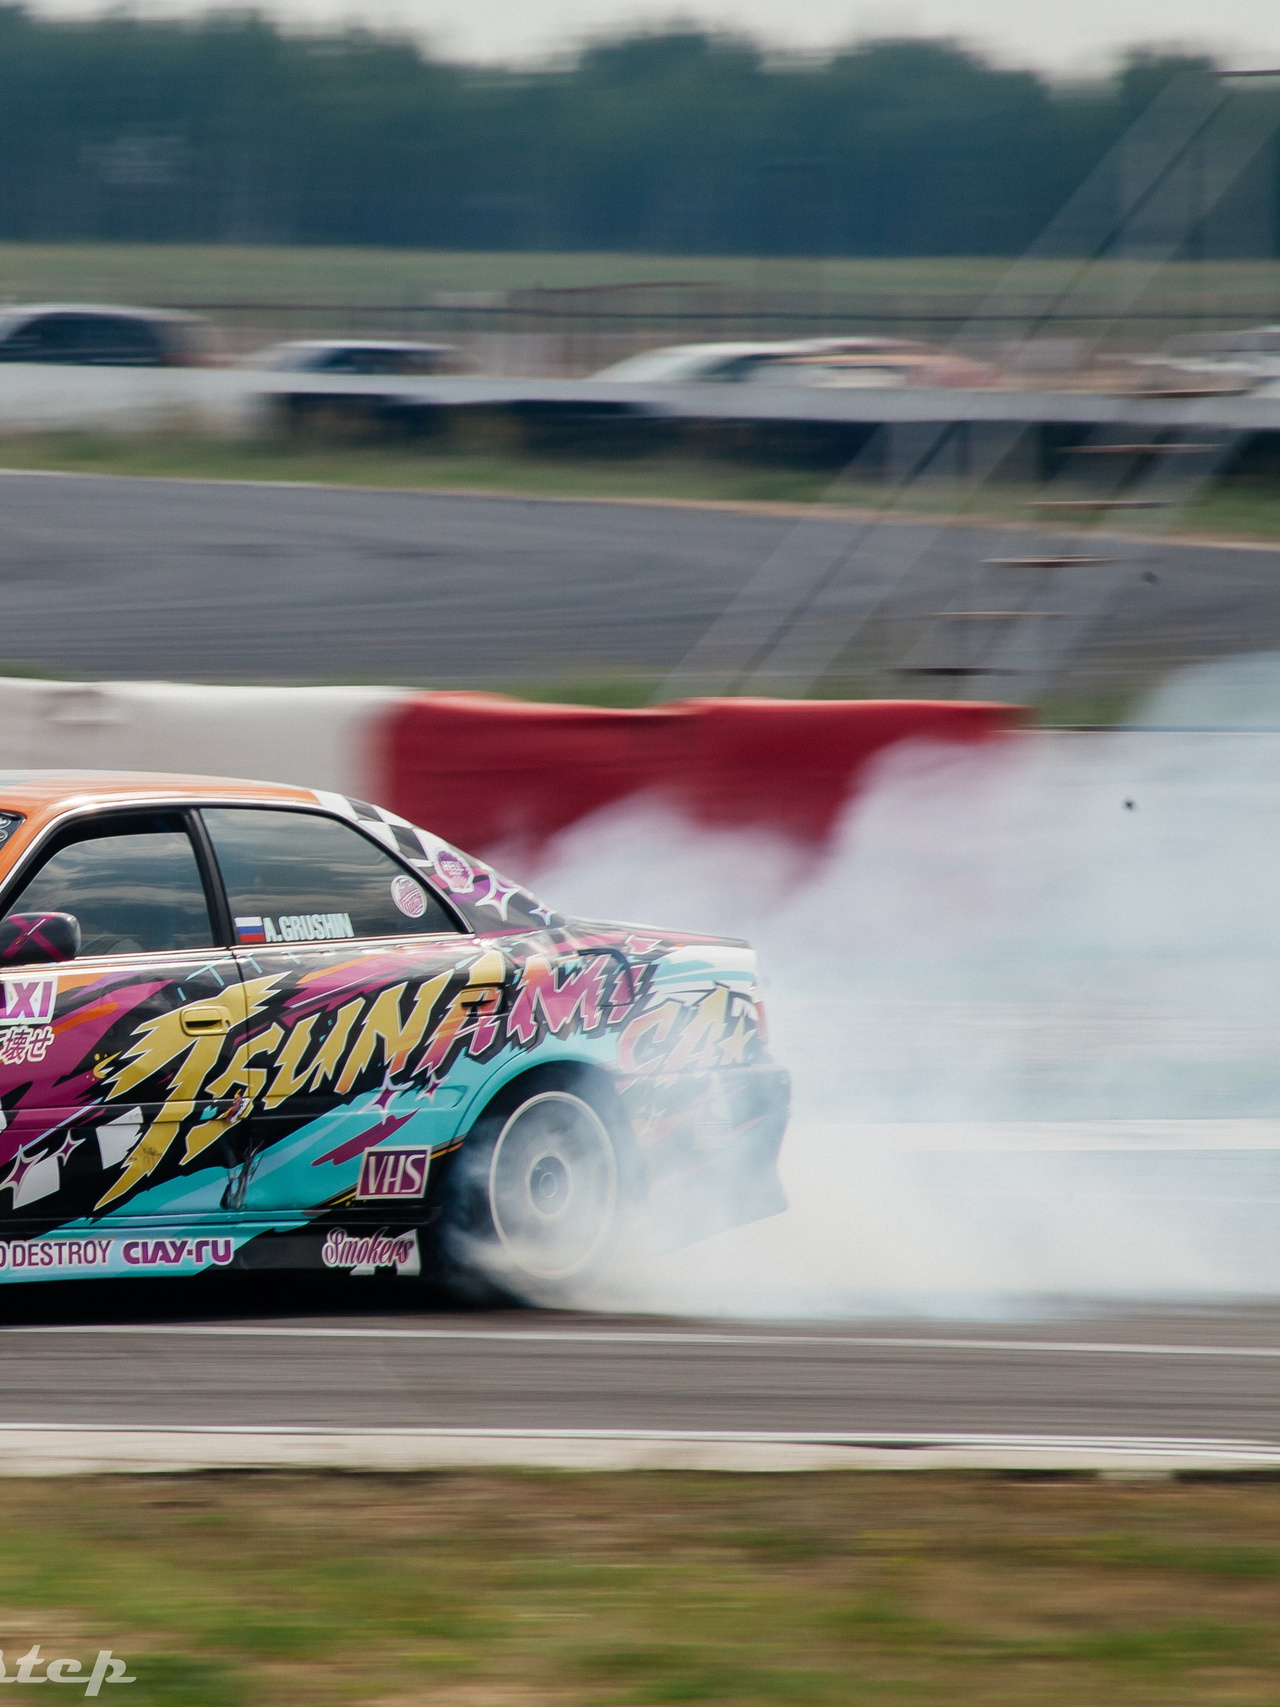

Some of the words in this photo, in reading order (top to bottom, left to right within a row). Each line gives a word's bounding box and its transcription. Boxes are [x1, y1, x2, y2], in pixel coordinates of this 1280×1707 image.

[263, 913, 355, 942] A.GRUSHIN
[93, 937, 662, 1211] TSUNAMI
[366, 1153, 427, 1194] VHS
[10, 1239, 114, 1268] DESTROY
[322, 1227, 416, 1266] Smokers
